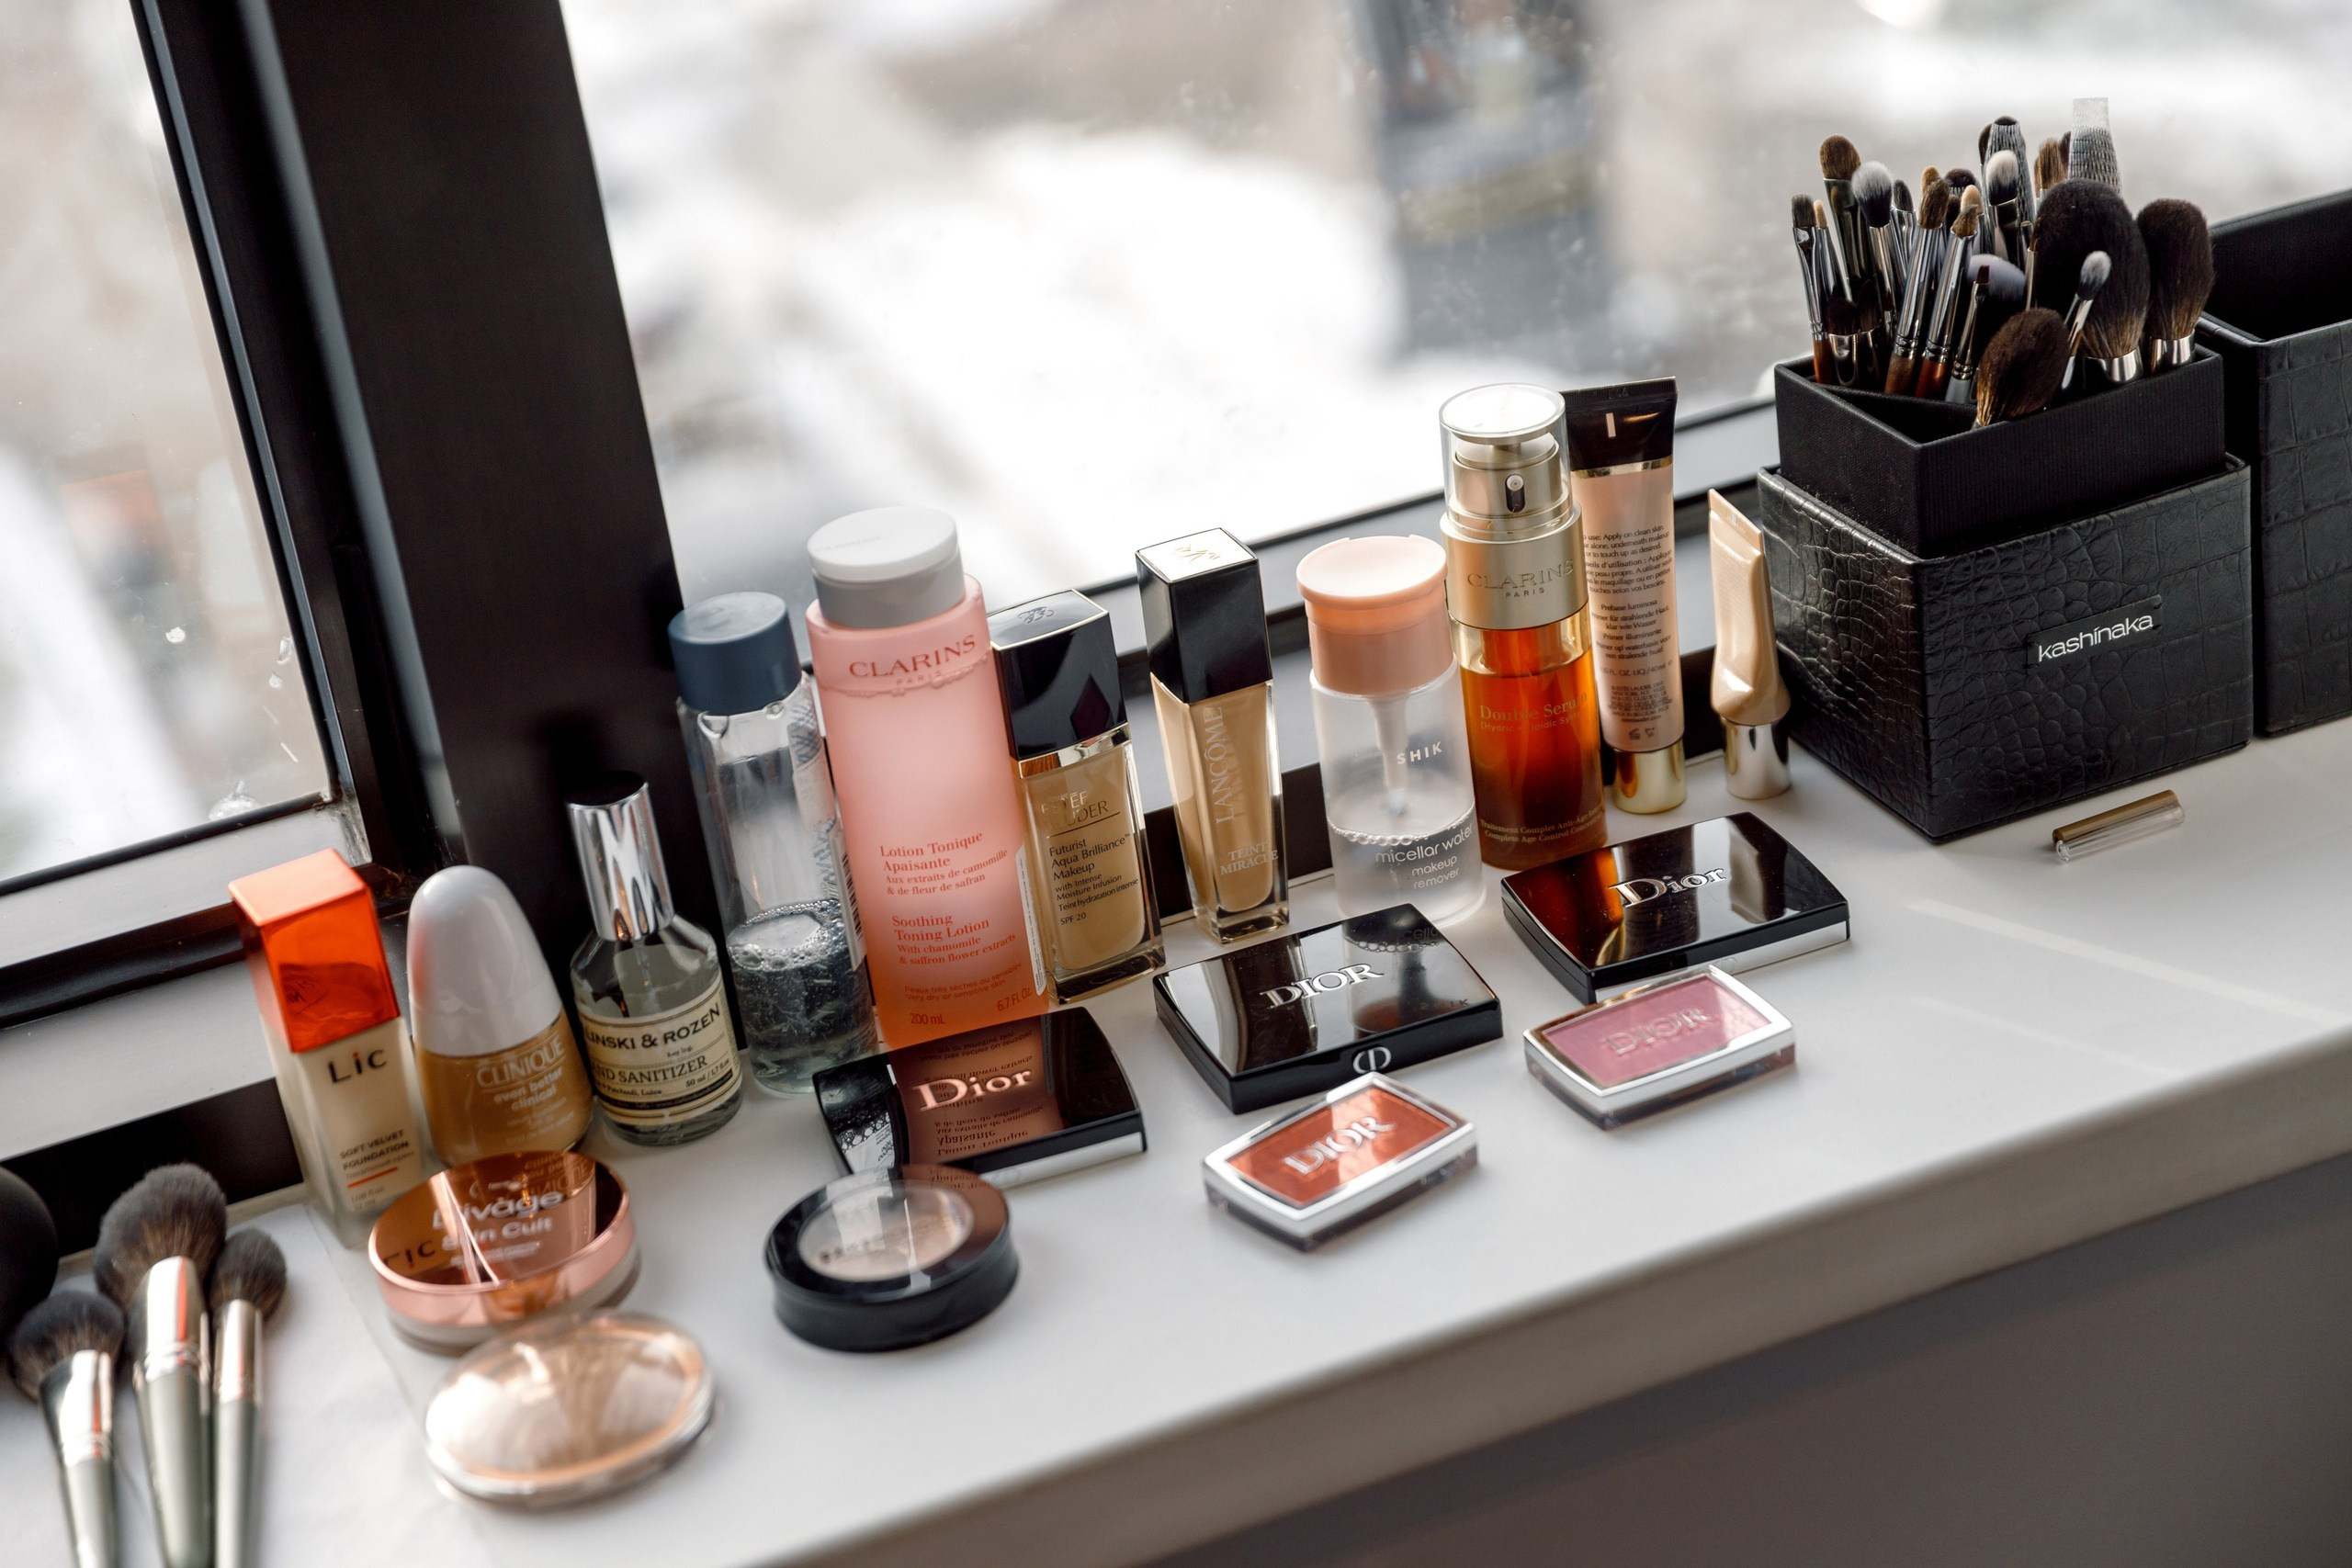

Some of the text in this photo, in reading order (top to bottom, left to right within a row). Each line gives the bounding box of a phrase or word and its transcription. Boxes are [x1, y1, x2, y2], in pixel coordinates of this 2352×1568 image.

[1603, 533, 1623, 542] Apply
[1634, 528, 1651, 536] clean
[1611, 537, 1647, 548] underneath
[1648, 532, 1669, 543] makeup
[1600, 549, 1619, 558] touch
[1467, 558, 1575, 590] CLARINS
[1600, 577, 1635, 587] maquillage
[1505, 586, 1545, 598] PARIS
[1612, 586, 1630, 594] selon
[1601, 600, 1657, 612] Prebase luminosa
[1620, 610, 1655, 622] strahlende
[1633, 619, 1657, 628] Wasser
[1624, 639, 1659, 650] waterbasis
[2037, 614, 2155, 663] kashinaka
[848, 634, 976, 678] CLARINS
[1618, 650, 1648, 660] stralende
[1649, 646, 1664, 656] huid
[896, 670, 943, 686] PARIS
[1479, 705, 1539, 722] Double
[1543, 692, 1588, 717] Serum
[1396, 740, 1442, 766] SHIK
[1203, 706, 1236, 825] LANCÔME
[1480, 818, 1520, 834] Traitement
[1521, 824, 1555, 834] Complet
[1485, 829, 1569, 843] Complete Age Control
[879, 832, 984, 858] Lotion Tonique
[1049, 839, 1087, 857] Futurist
[1227, 840, 1268, 862] TEINT
[1375, 822, 1474, 863] micellar water
[883, 857, 951, 874] Apaisante
[885, 849, 1009, 884] Aux extraits de camomille
[1051, 853, 1080, 869] Aqua
[1053, 862, 1096, 881] Makeup
[1219, 849, 1280, 875] MIRACLE
[1412, 854, 1458, 876] makeup
[887, 874, 986, 896] & de fleur de safran
[1056, 873, 1102, 892] with Intense
[1057, 874, 1123, 901] Moisture Infusion
[1413, 867, 1461, 889] remover
[1608, 867, 1728, 909] Dior
[1058, 878, 1138, 912] Teint hydratation intense
[892, 914, 954, 927] Soothing
[1060, 911, 1087, 926] SPF 20
[894, 919, 990, 942] Toning Lotion
[897, 936, 981, 953] With chamomile
[899, 932, 1016, 964] & saffron flower extracts
[904, 985, 928, 994] Peaux
[926, 993, 940, 1002] dry
[954, 986, 989, 999] sensitive
[990, 978, 1006, 991] skin
[1260, 962, 1385, 1010] DIOR
[997, 998, 1010, 1012] 6.7
[585, 1002, 720, 1049] LINSKI & ROZEN
[910, 1013, 946, 1025] 200 mL
[1601, 1007, 1713, 1056] DIOR
[477, 1034, 564, 1087] CLINIQUE
[618, 1055, 707, 1084] SANITIZER
[494, 1066, 563, 1104] even better
[912, 1068, 1034, 1113] Dior
[511, 1082, 558, 1111] clinical
[340, 1129, 404, 1159] SOFT VELVET
[1283, 1115, 1397, 1176] DIOR
[343, 1140, 410, 1171] FOUNDATION
[442, 1217, 552, 1250] Sin Cult
